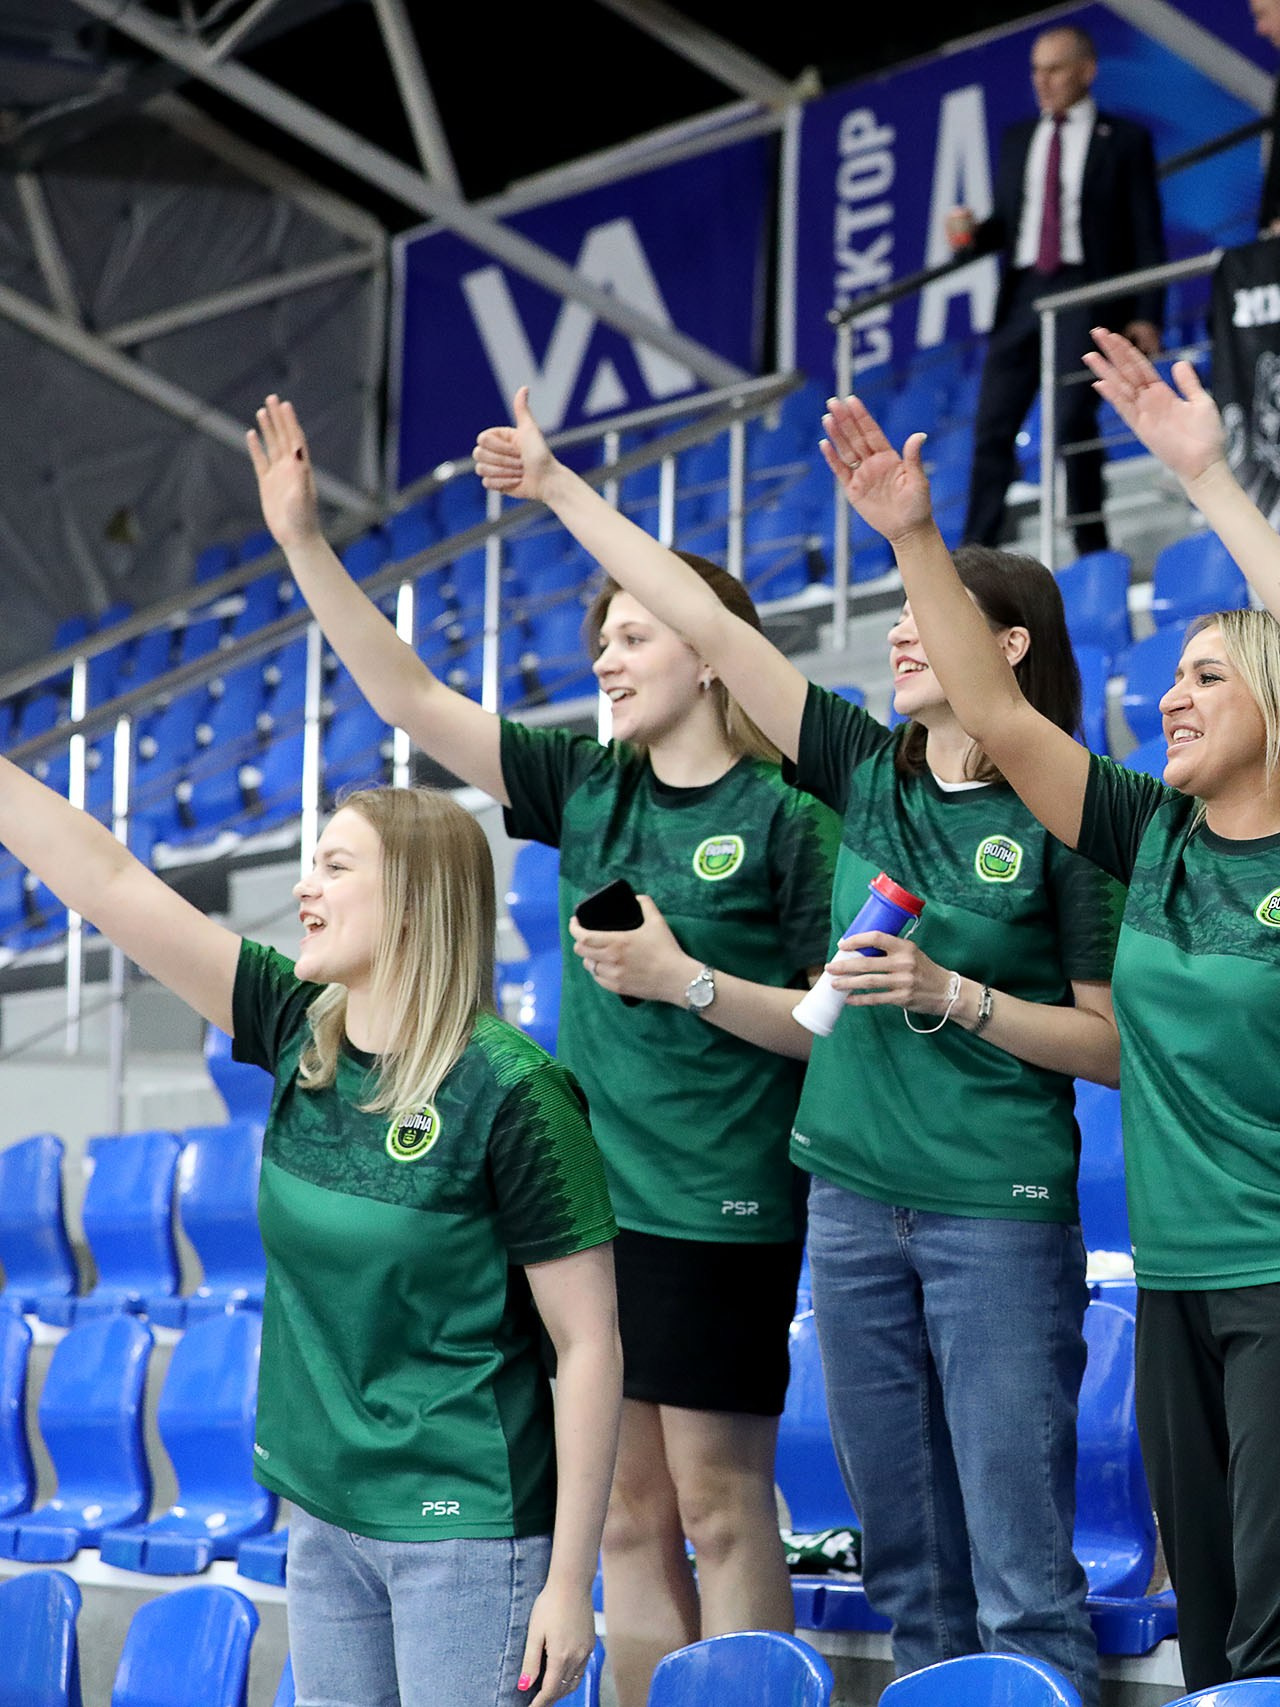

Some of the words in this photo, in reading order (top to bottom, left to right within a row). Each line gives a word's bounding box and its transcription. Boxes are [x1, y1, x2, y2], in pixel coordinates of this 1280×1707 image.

[983, 842, 1017, 863] ВОЛНА
[1011, 1184, 1050, 1200] PSR
[721, 1200, 759, 1216] PSR
[422, 1500, 460, 1516] PSR
